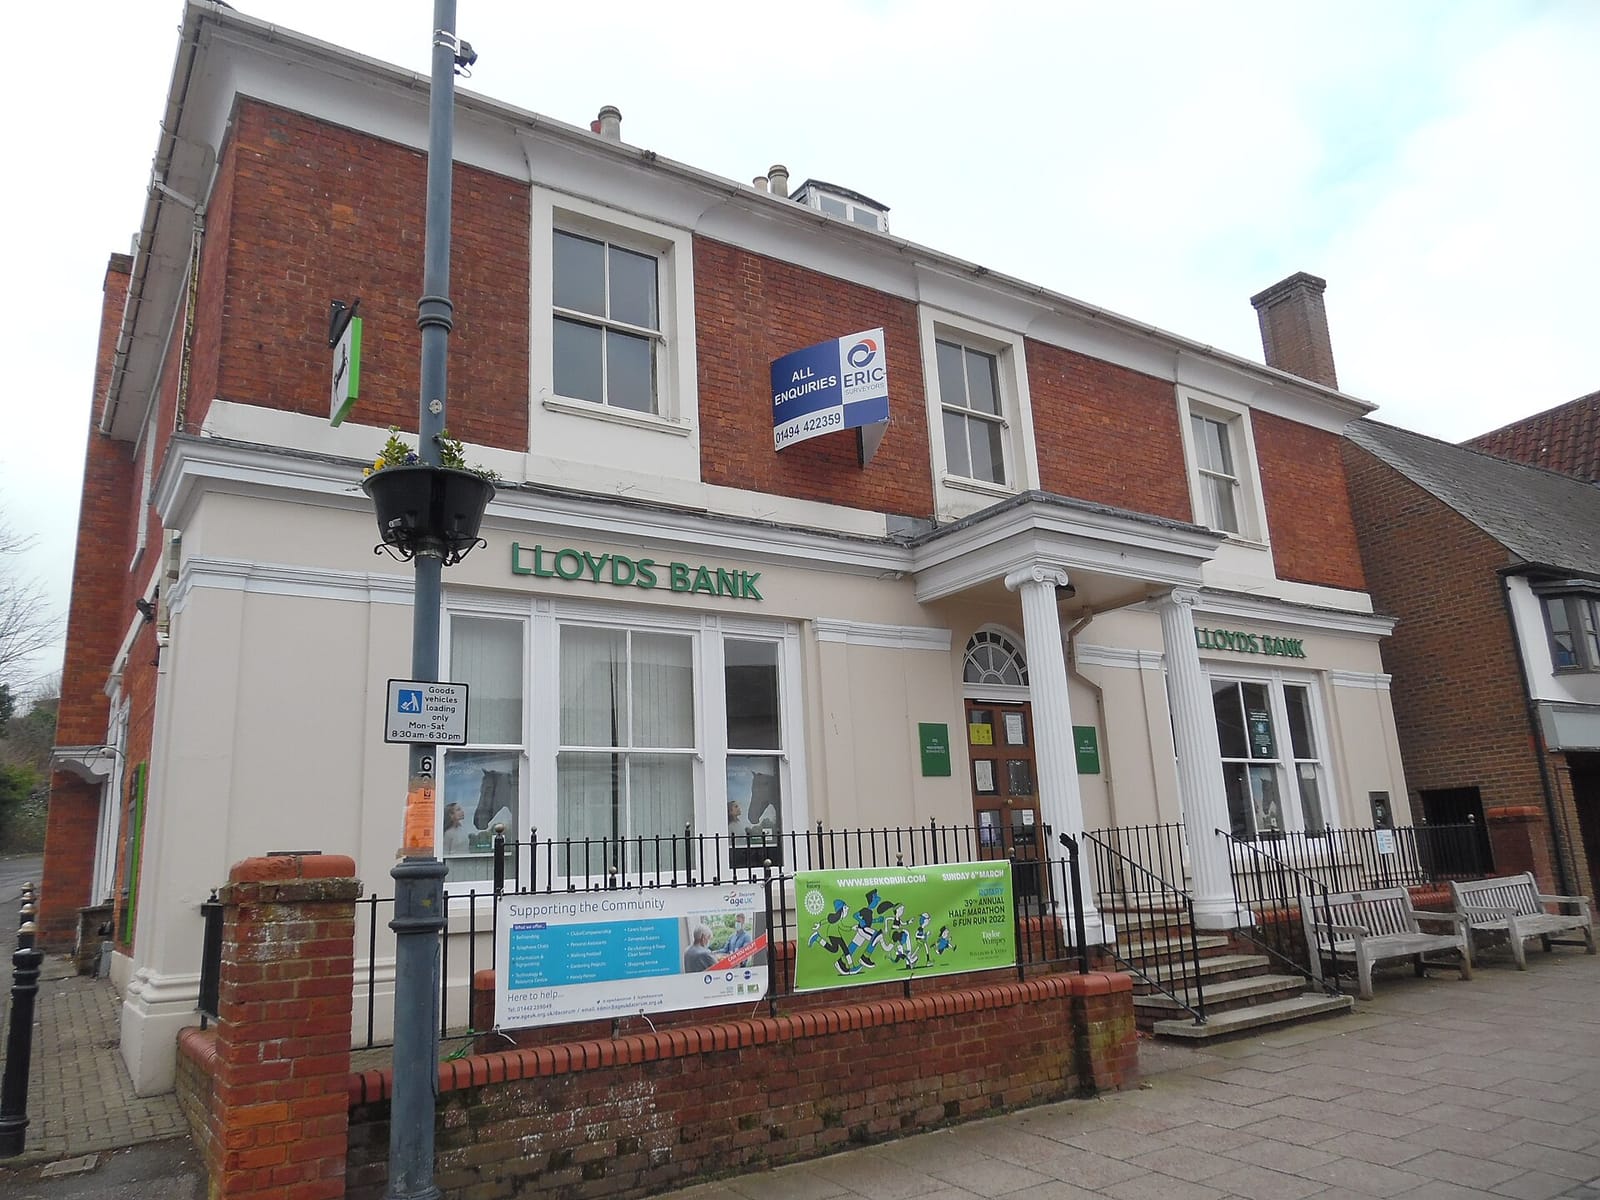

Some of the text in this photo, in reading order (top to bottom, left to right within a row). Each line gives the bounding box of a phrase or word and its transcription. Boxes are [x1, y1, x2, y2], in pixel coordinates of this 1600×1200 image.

[792, 366, 815, 383] ALL
[843, 367, 884, 388] ERIC
[774, 375, 837, 406] ENQUIRIES
[845, 382, 885, 396] SURVEYORS
[775, 412, 841, 444] 01494 422359
[512, 541, 764, 600] LLOYDS BANK
[1194, 626, 1307, 659] LLOYDS BANK
[428, 686, 455, 695] Goods
[424, 696, 458, 704] vehicles
[426, 704, 456, 713] loading
[432, 714, 449, 722] only
[837, 874, 927, 887] WWW.BERKORUN.COM
[942, 872, 970, 881] SUNDAY
[979, 869, 1004, 878] MARCH
[510, 897, 665, 918] Supporting the Community
[978, 897, 1004, 906] ANNUAL
[948, 906, 1005, 918] HALF MARATHON
[958, 918, 972, 926] FUN
[973, 916, 987, 925] RUN
[989, 915, 1005, 923] 2022
[507, 994, 527, 1002] Here
